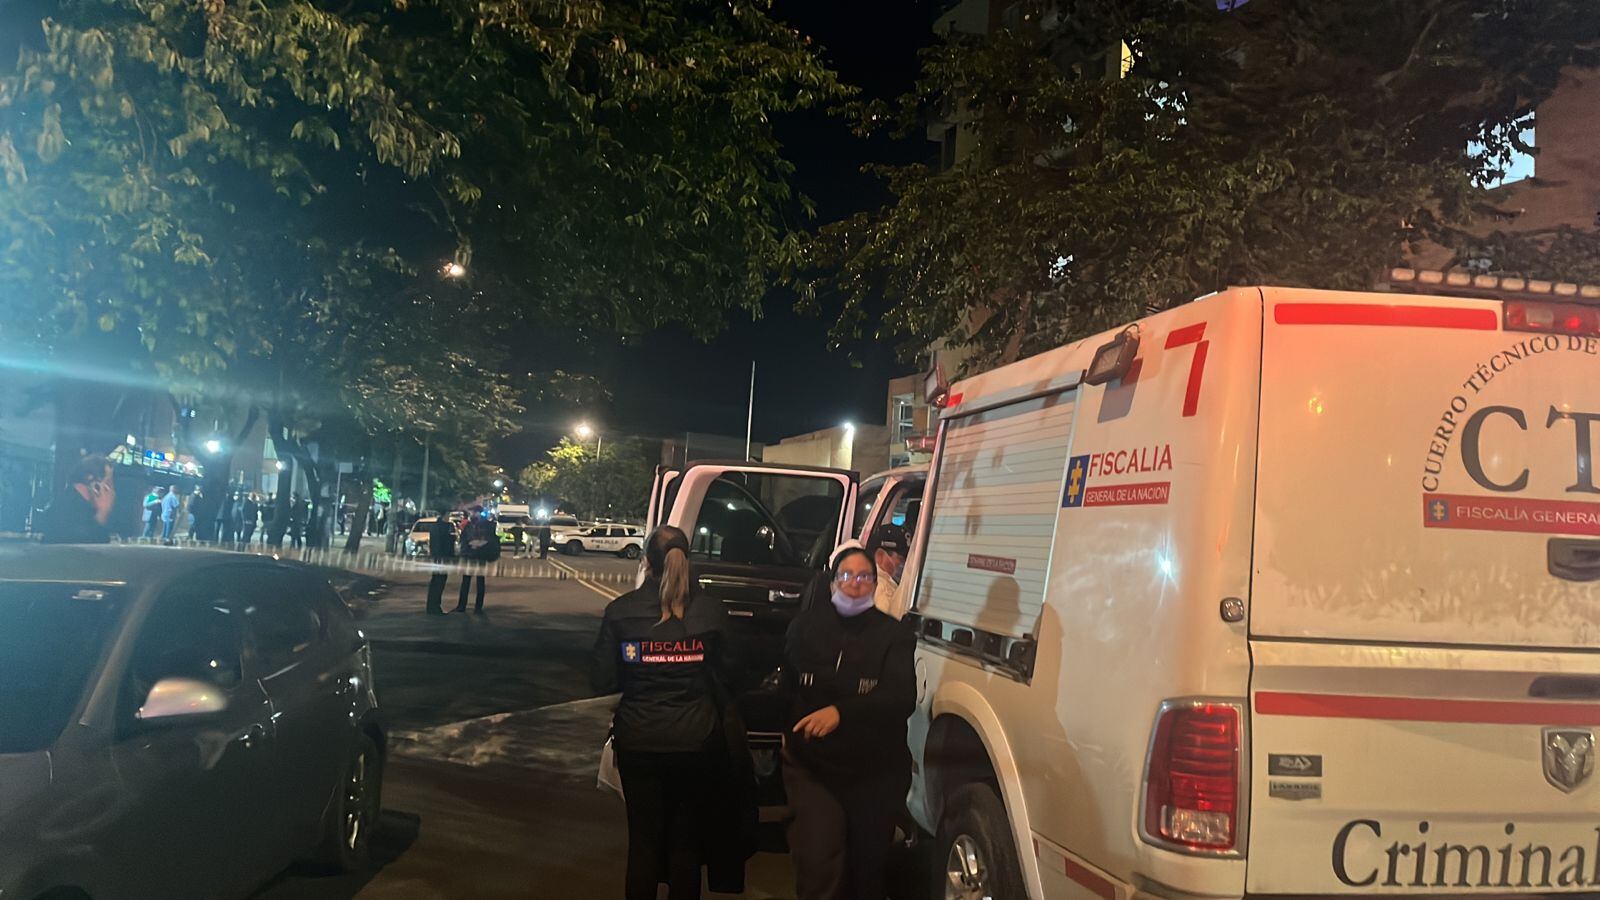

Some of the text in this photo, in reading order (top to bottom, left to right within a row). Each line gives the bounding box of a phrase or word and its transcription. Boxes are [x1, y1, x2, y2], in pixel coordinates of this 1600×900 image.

[1422, 335, 1598, 492] CUERPO TÉCNICO DE
[1086, 489, 1116, 503] GENERAL
[1117, 488, 1127, 501] DE
[1128, 487, 1137, 501] LA
[1456, 505, 1529, 521] FISCALÍA
